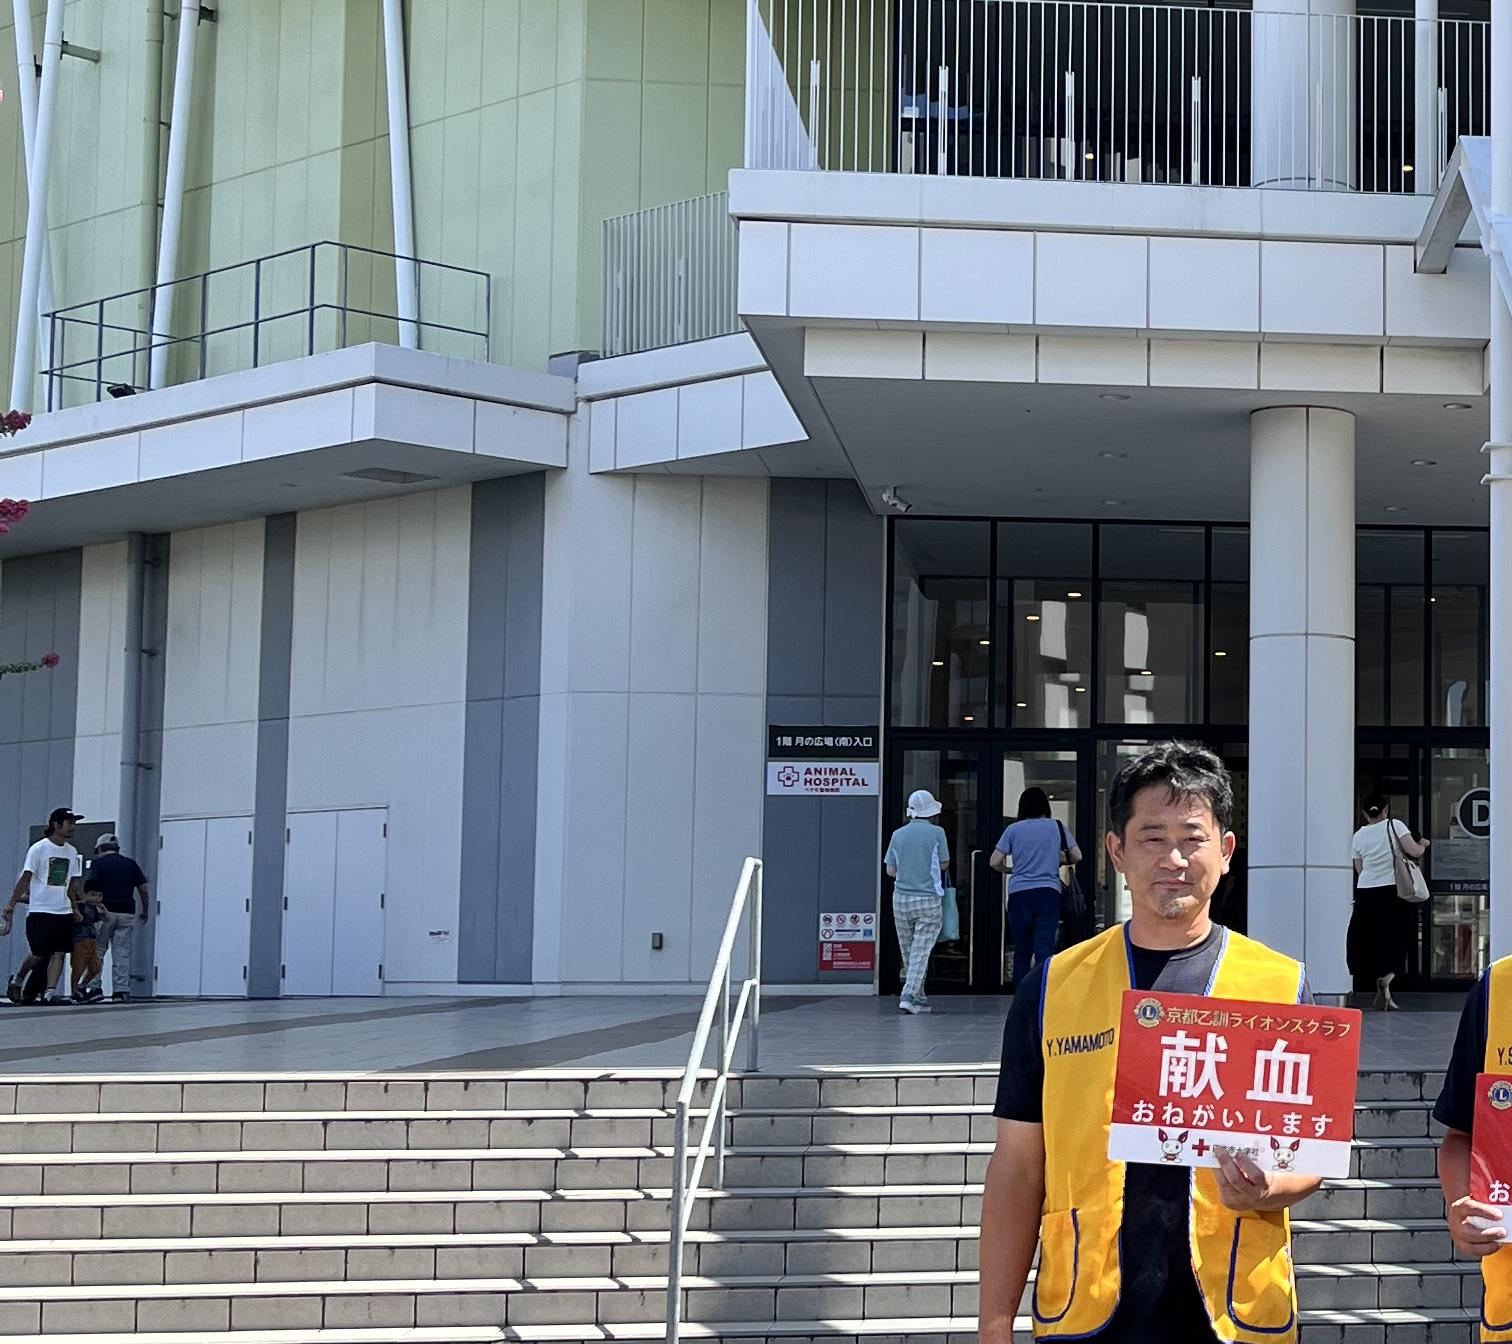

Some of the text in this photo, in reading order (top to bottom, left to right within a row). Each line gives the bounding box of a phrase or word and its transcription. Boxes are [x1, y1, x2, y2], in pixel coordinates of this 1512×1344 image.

[803, 767, 857, 776] ANIMAL
[803, 777, 869, 787] HOSPITAL
[1472, 800, 1490, 827] D
[1166, 1006, 1352, 1038] 京都乙訓ライオンズクラブ
[1158, 1029, 1314, 1105] 献血
[1131, 1099, 1334, 1137] おねがいします
